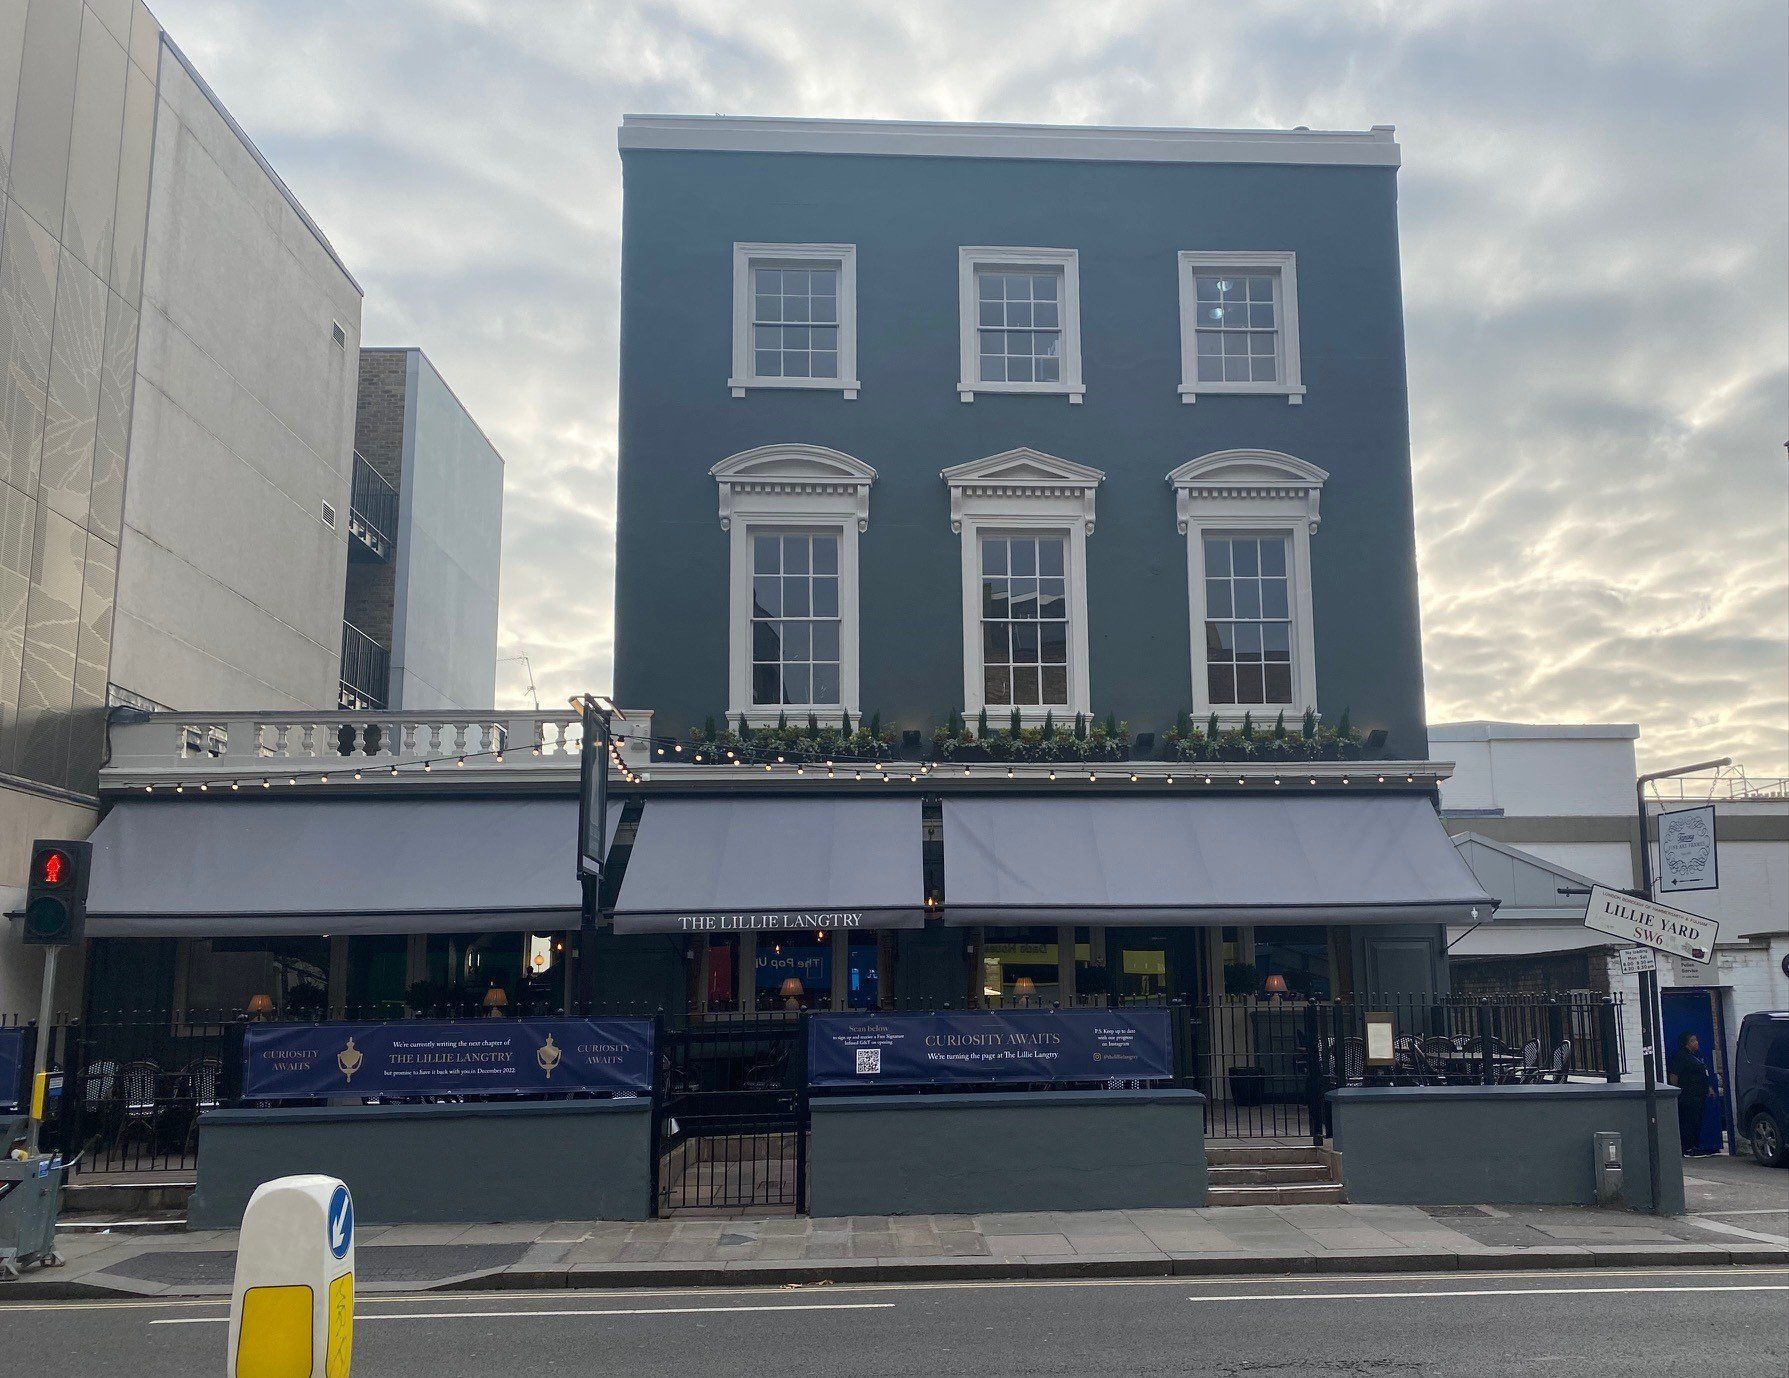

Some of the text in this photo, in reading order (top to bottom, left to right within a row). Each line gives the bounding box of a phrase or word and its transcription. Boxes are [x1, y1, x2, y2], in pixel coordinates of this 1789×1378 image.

[678, 913, 862, 930] THE LILLIE LANGTRY
[1605, 901, 1700, 940] LILLIE YARD
[1633, 926, 1664, 946] SW6
[925, 1032, 1060, 1047] CURIOSITY AWAITS
[262, 1050, 320, 1059] CURIOSITY
[389, 1052, 513, 1064] THE LILLIE LANGTRY
[946, 1052, 969, 1060] turning
[1004, 1050, 1015, 1058] The
[1034, 1050, 1058, 1060] Langtry
[272, 1062, 310, 1070] AWAITS
